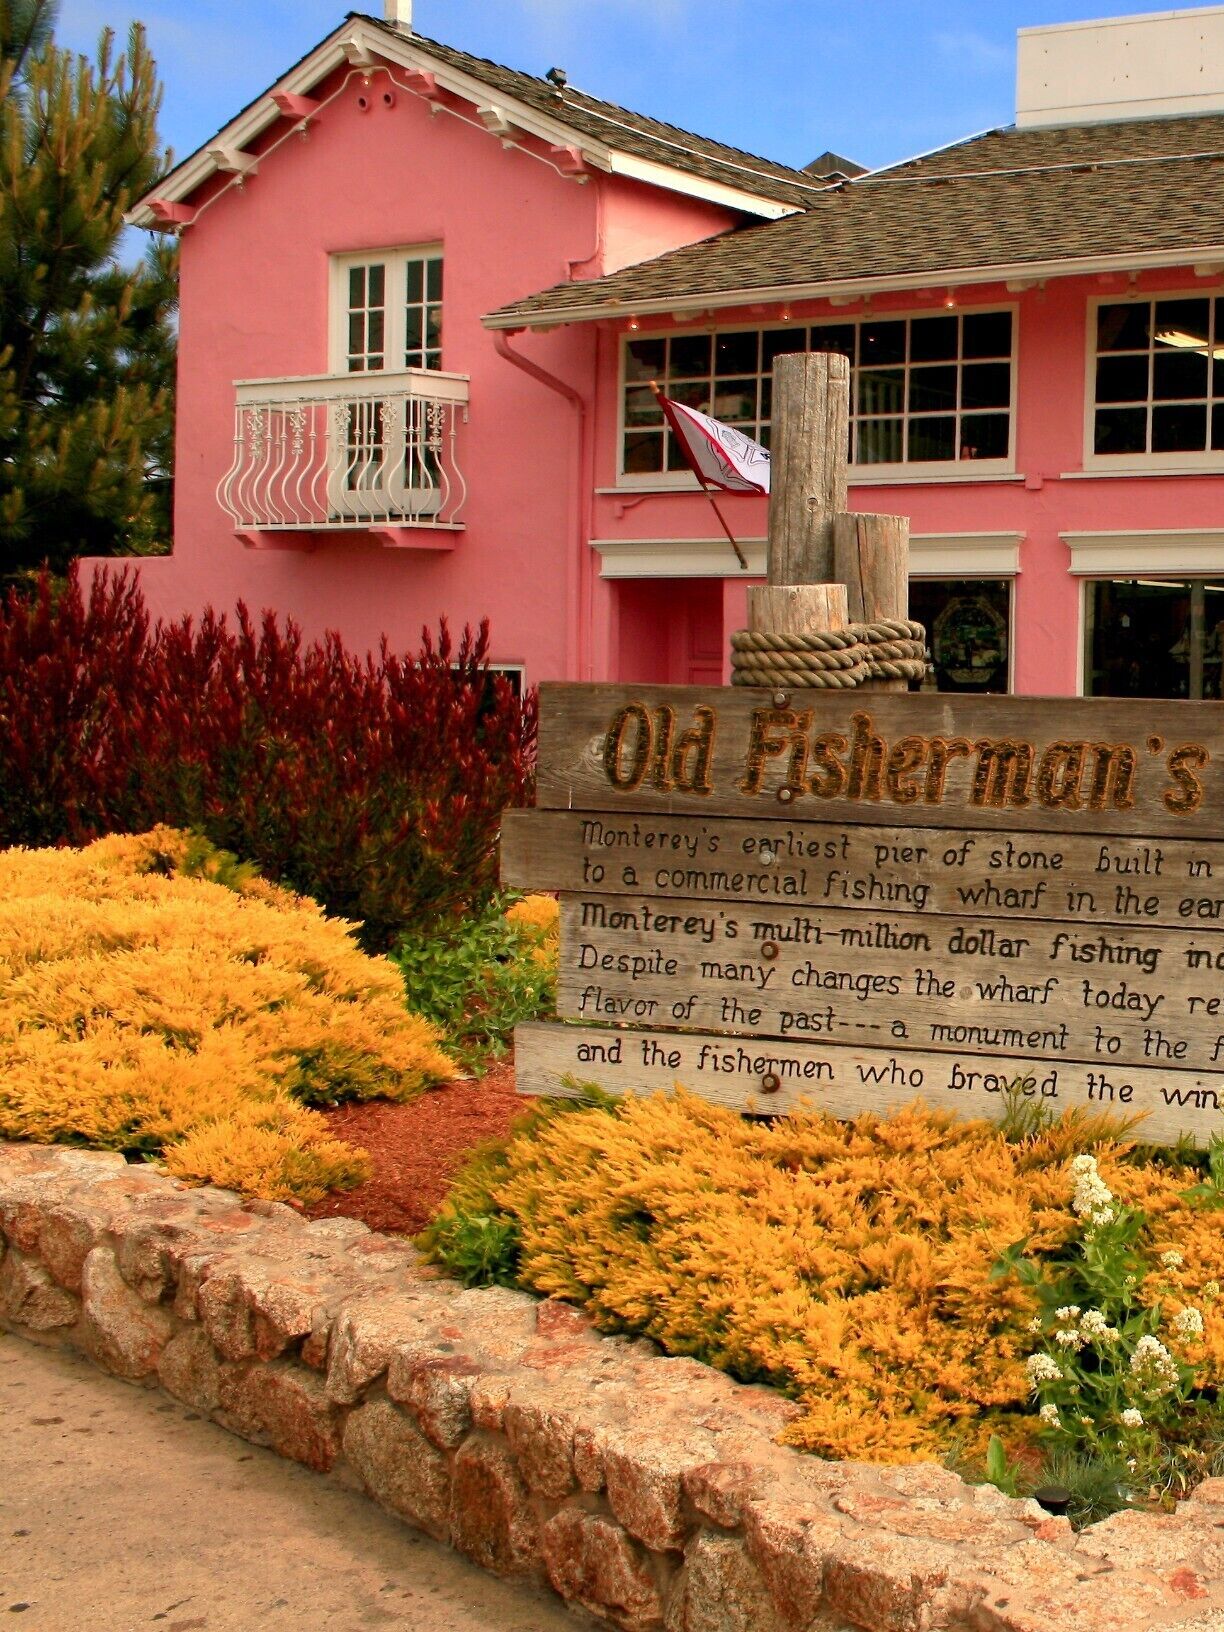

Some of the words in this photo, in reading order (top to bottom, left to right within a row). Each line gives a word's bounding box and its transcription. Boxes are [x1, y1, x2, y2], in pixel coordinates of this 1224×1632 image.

[603, 700, 717, 794] Old
[739, 707, 1210, 816] Fisherman's
[581, 821, 720, 855] Monterey's
[741, 829, 851, 861] earliest
[875, 842, 927, 867] pier
[943, 841, 974, 867] of
[989, 843, 1064, 870] stone
[1095, 846, 1163, 876] built
[1187, 856, 1212, 877] in
[582, 857, 604, 883] to
[622, 868, 640, 886] a
[655, 865, 807, 896] commercial
[824, 863, 930, 908] fishing
[957, 879, 1048, 909] wharf
[1067, 886, 1097, 912] in
[1115, 888, 1160, 916] the
[580, 902, 738, 943] Monterey's
[752, 916, 932, 953] multi-million
[948, 927, 1029, 959] dollar
[1050, 932, 1162, 974] fishing
[578, 944, 678, 978] Despite
[700, 959, 776, 988] many
[791, 962, 901, 1000] changes
[914, 969, 956, 998] the
[975, 977, 1058, 1006] wharf
[1083, 980, 1164, 1022] today
[577, 985, 660, 1017] flavor
[671, 995, 697, 1021] of
[720, 997, 762, 1025] the
[930, 1023, 1070, 1051] monument
[1095, 1026, 1121, 1055] to
[1143, 1027, 1188, 1059] the
[576, 1039, 622, 1064] and
[642, 1040, 682, 1070] the
[697, 1045, 834, 1081] fishermen
[856, 1059, 924, 1089] who
[948, 1064, 1058, 1098] braved
[1088, 1074, 1134, 1103] the
